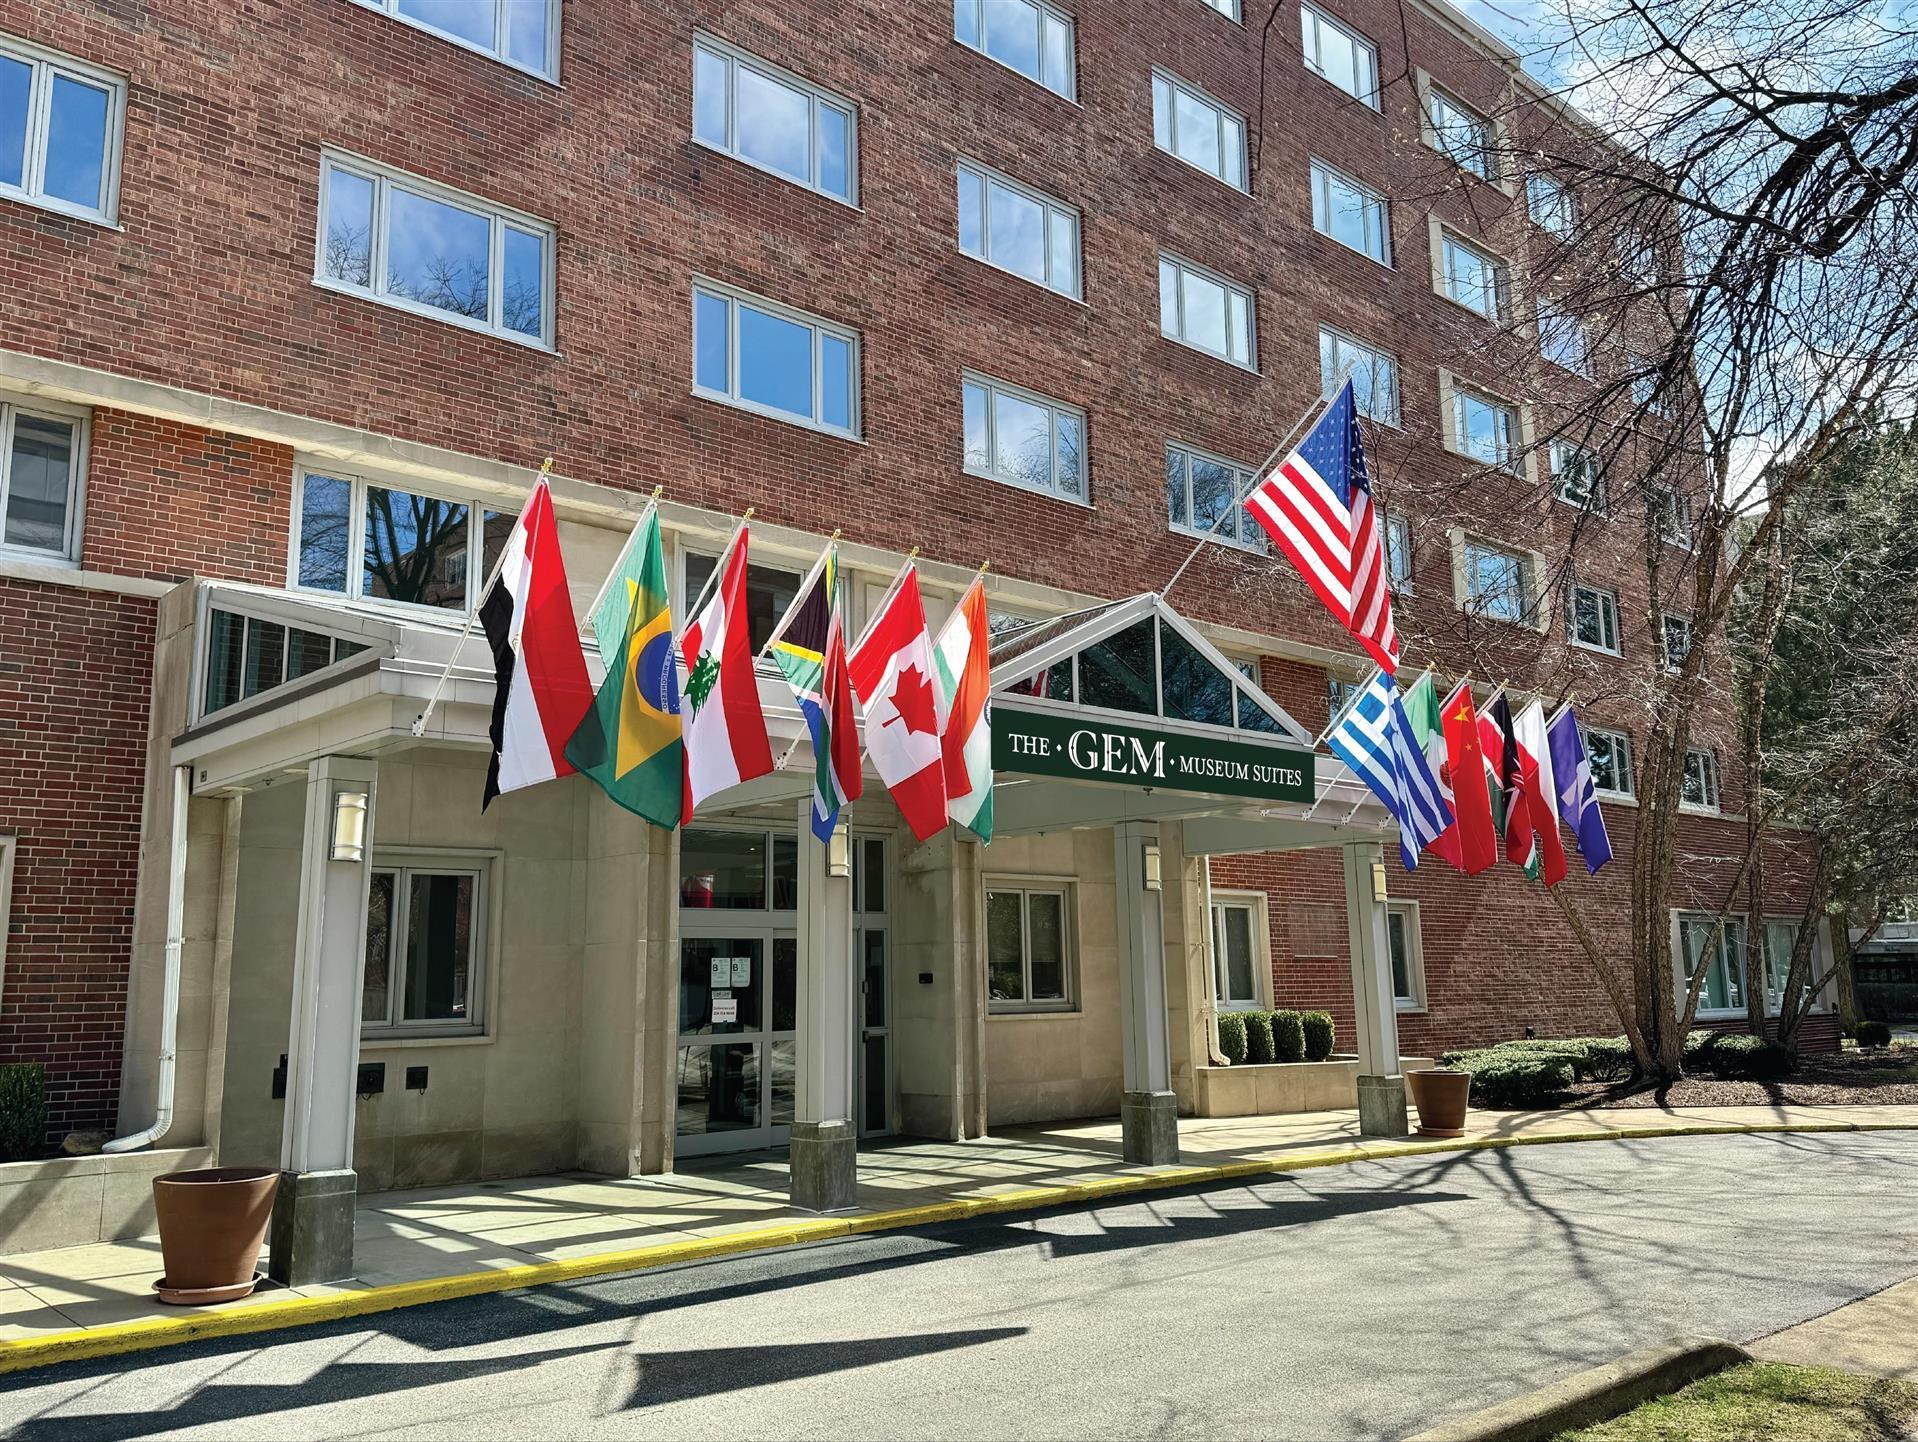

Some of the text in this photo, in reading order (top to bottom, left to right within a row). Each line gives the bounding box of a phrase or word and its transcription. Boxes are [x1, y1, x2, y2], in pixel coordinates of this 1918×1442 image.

[1008, 730, 1302, 787] THE GEM MUSEUM SUITES
